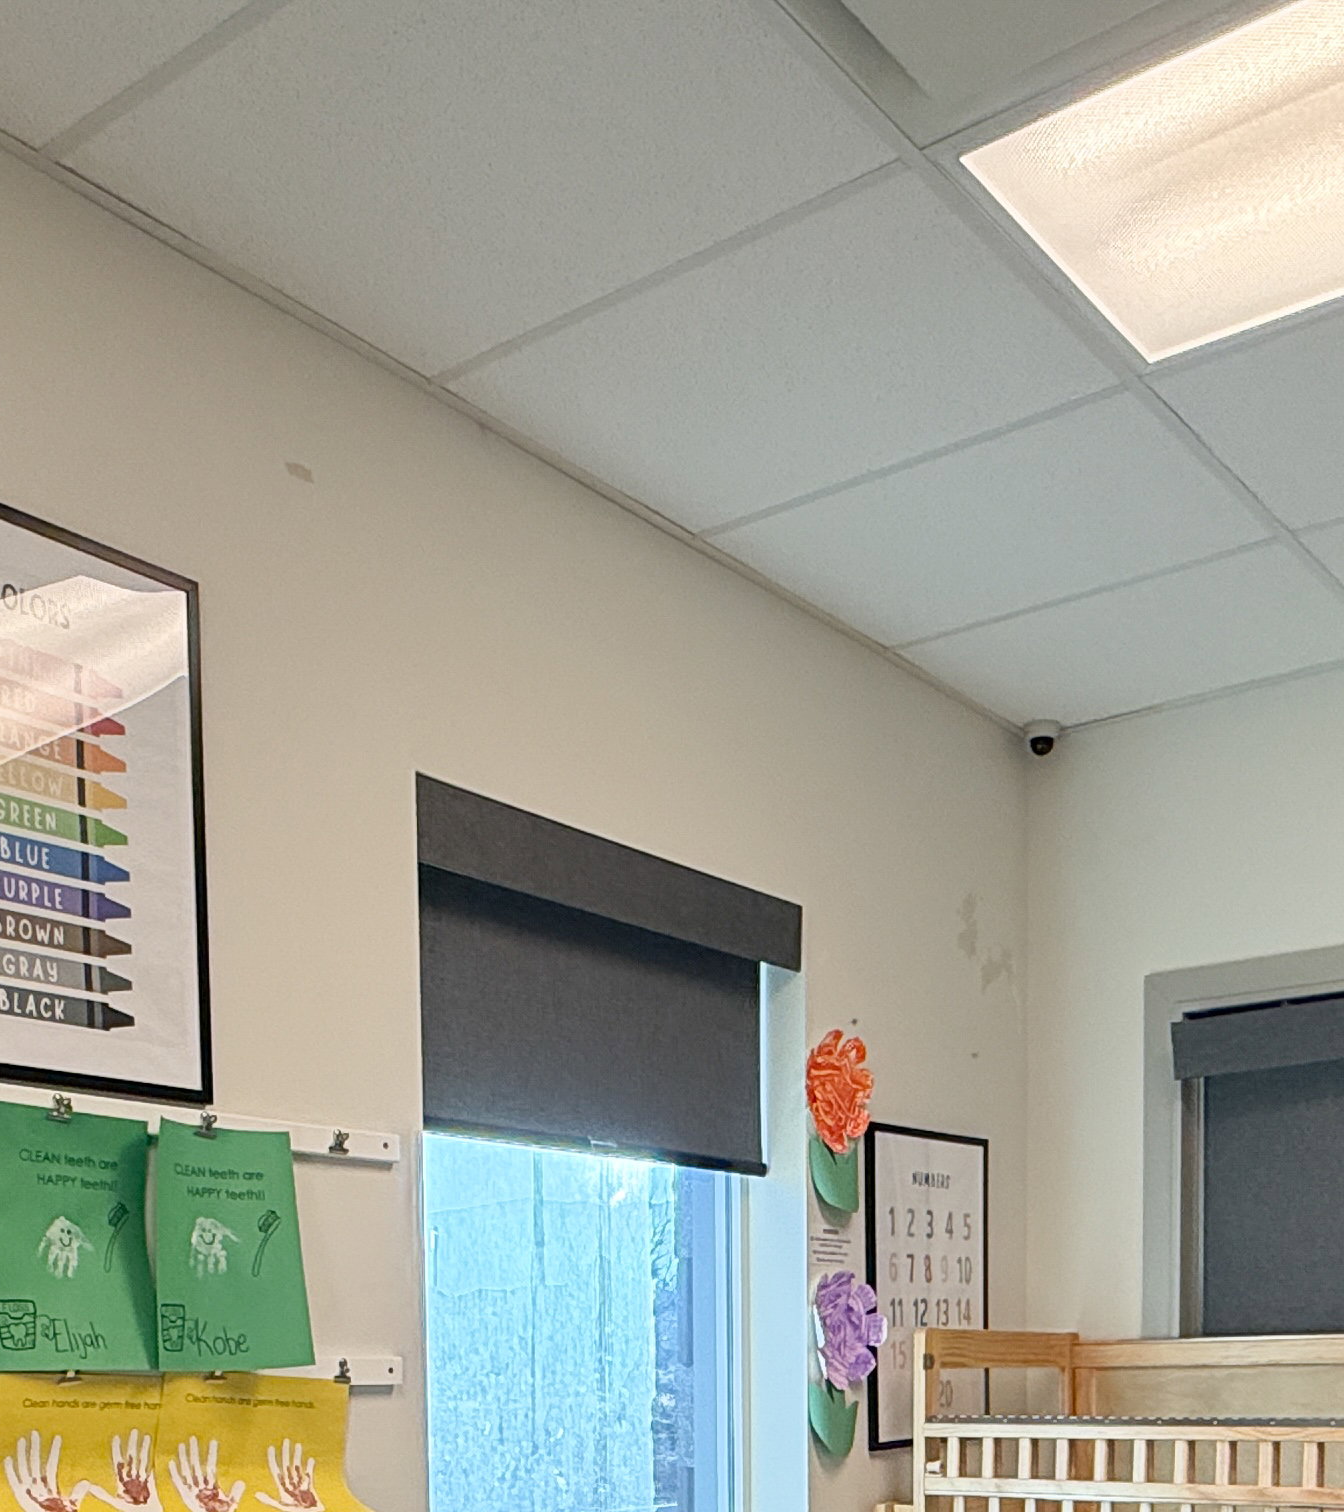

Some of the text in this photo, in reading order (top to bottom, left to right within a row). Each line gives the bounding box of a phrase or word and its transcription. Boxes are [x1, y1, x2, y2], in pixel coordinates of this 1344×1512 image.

[0, 835, 51, 869] BLUE
[2, 954, 58, 983] GRAY
[19, 1148, 118, 1171] CLEAN teeth are
[174, 1163, 264, 1182] CLEAN teeth are
[37, 1174, 77, 1188] HAPPY
[187, 1185, 221, 1199] HAPPY
[912, 1171, 951, 1189] NUMBERS
[888, 1206, 971, 1241] 1 2 3 4 5
[889, 1252, 972, 1285] 6 7 8 9 10
[890, 1298, 971, 1328] 11 12 13 14
[53, 1317, 109, 1360] Elijah
[194, 1317, 250, 1357] Kobe
[890, 1341, 906, 1370] 15
